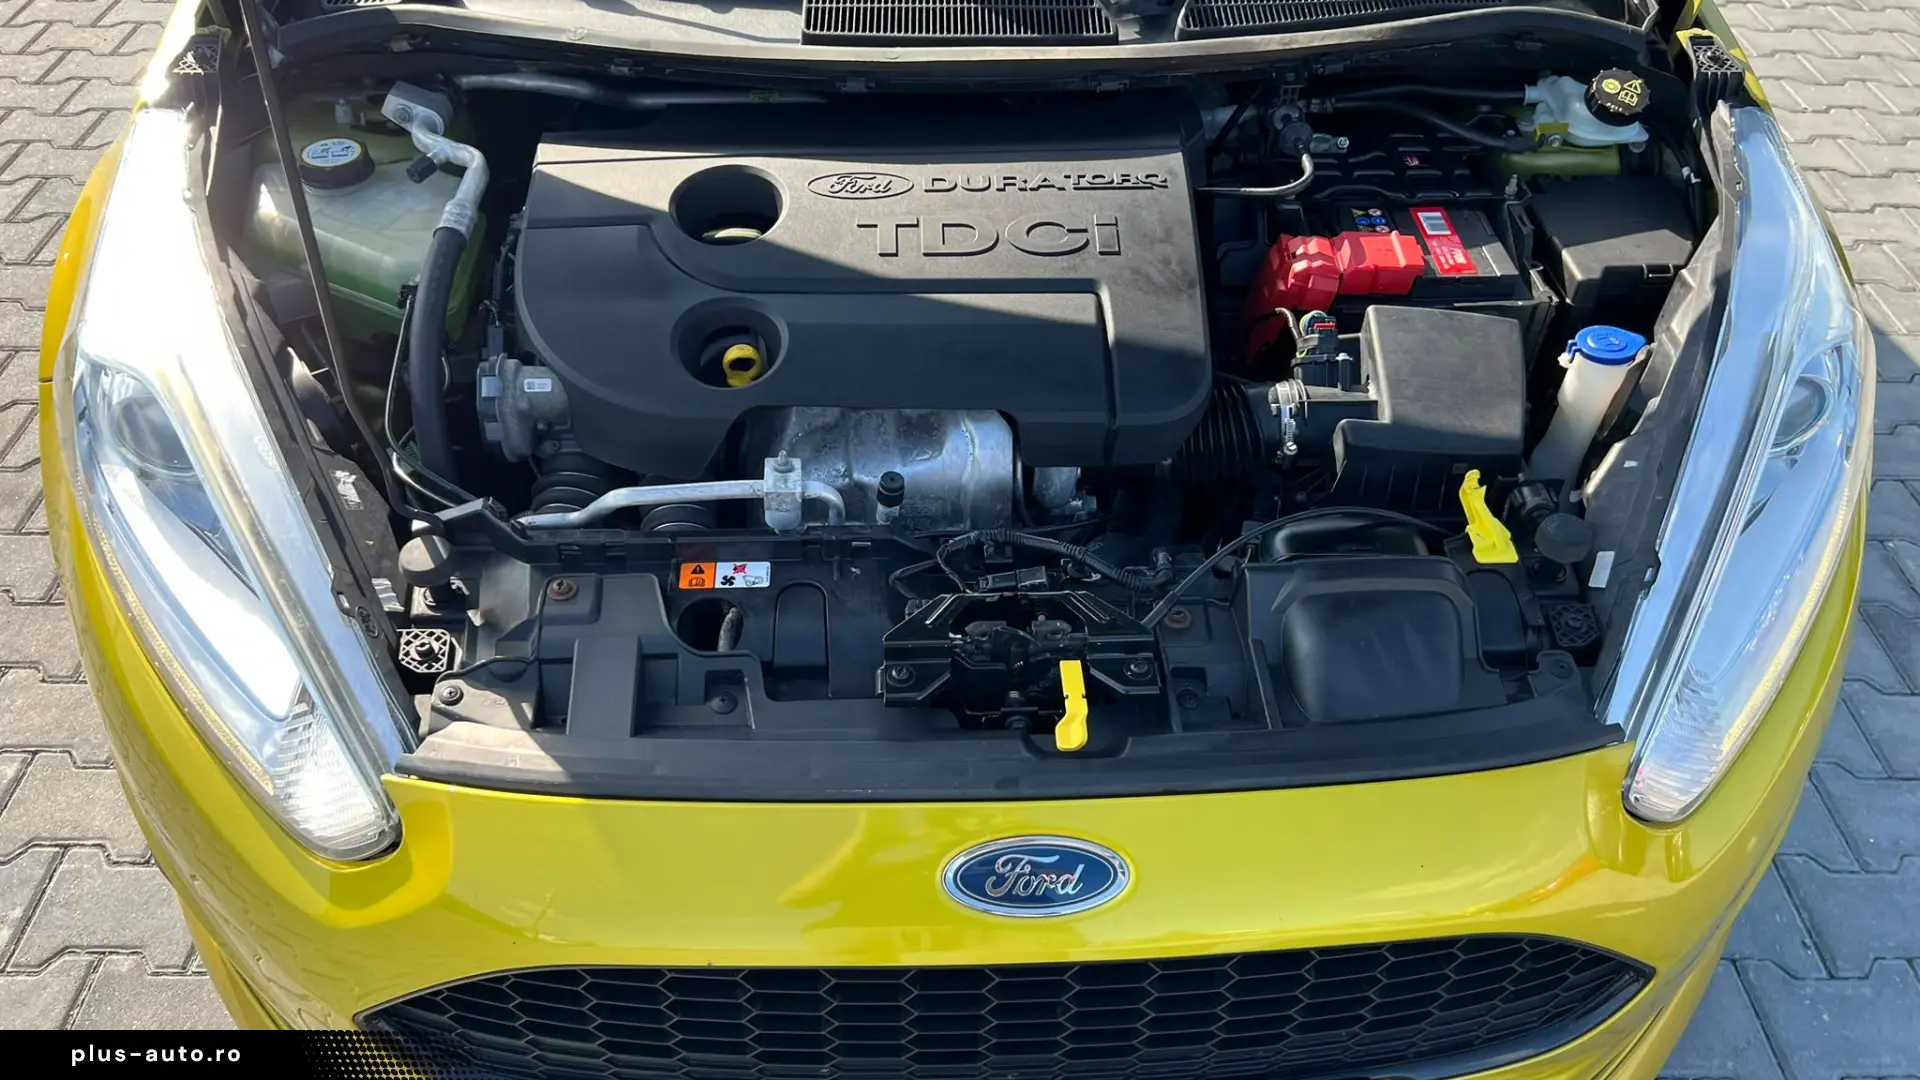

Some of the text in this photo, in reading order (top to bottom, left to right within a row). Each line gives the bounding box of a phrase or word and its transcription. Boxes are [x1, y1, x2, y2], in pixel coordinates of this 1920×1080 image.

[827, 173, 1169, 194] Ford DURATORQ
[857, 214, 1121, 257] TDCi
[985, 854, 1085, 897] Ford
